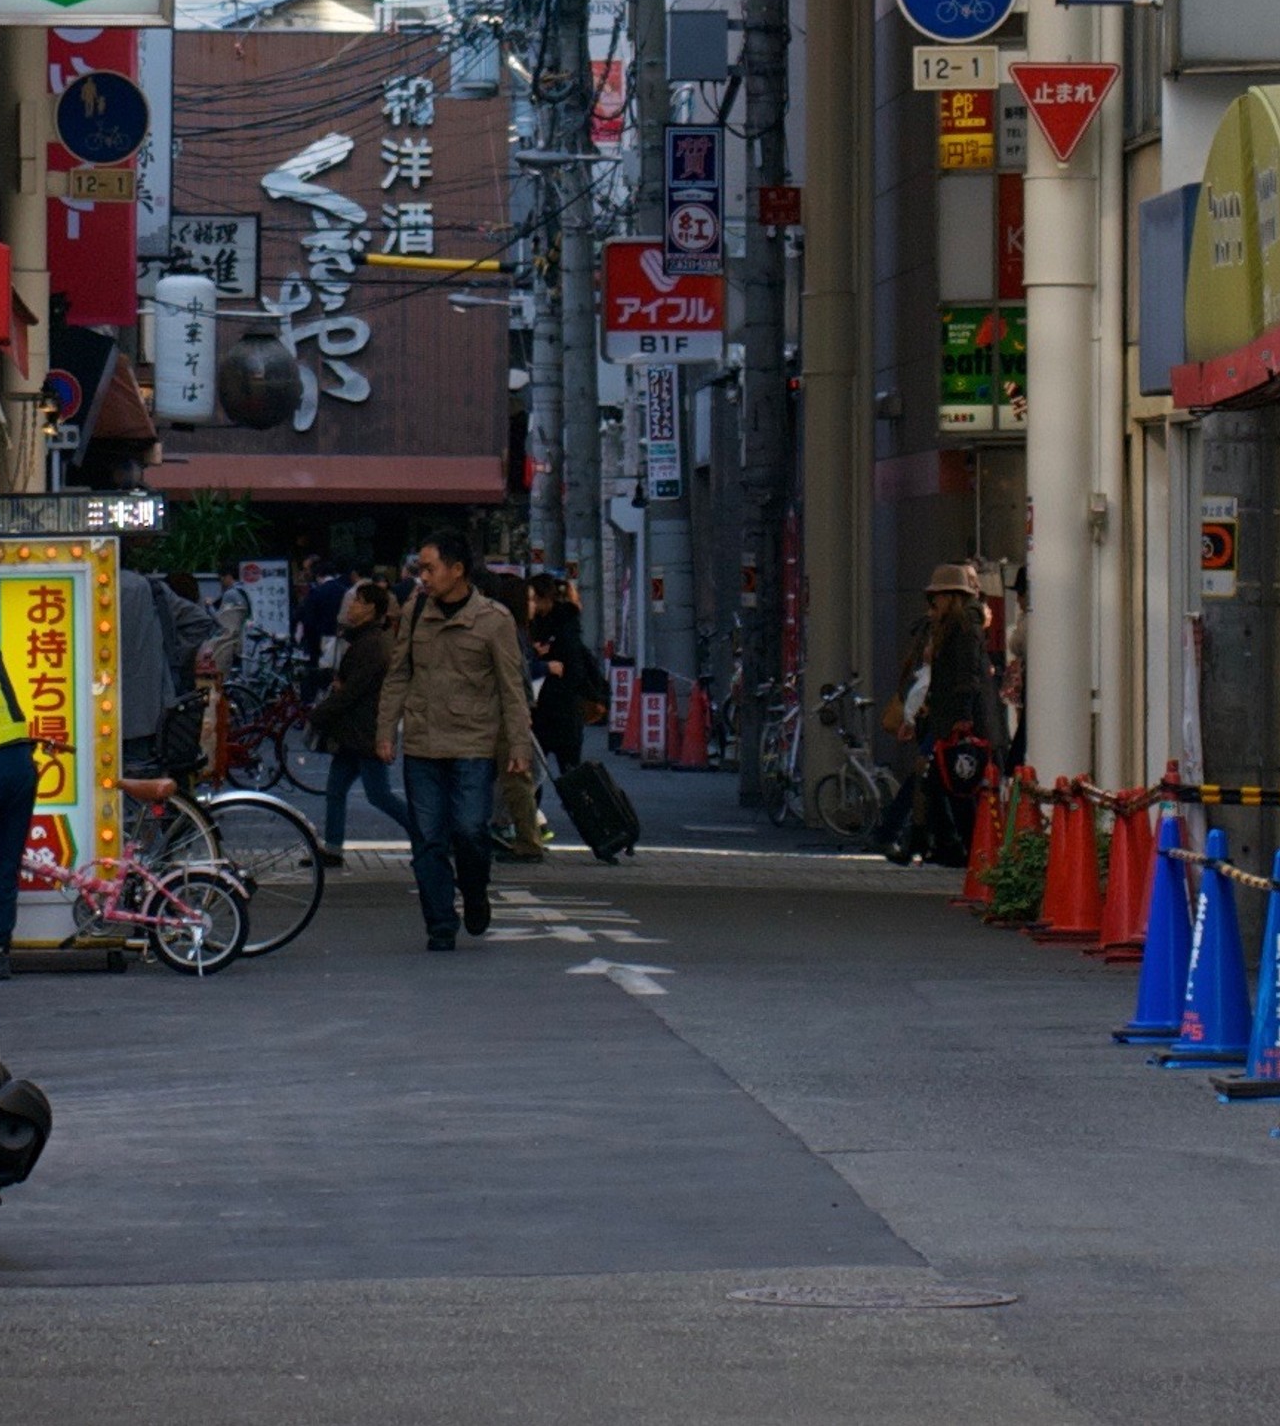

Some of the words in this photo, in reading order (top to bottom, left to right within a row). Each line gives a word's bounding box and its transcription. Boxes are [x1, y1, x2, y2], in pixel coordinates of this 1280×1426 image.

[1033, 82, 1096, 105] 止まれ
[75, 174, 126, 195] 12-1
[677, 210, 710, 243] 紅
[616, 296, 715, 325] アイフル
[181, 294, 207, 402] 中華そば
[639, 334, 690, 355] B1F
[26, 584, 69, 801] お持ち帰り
